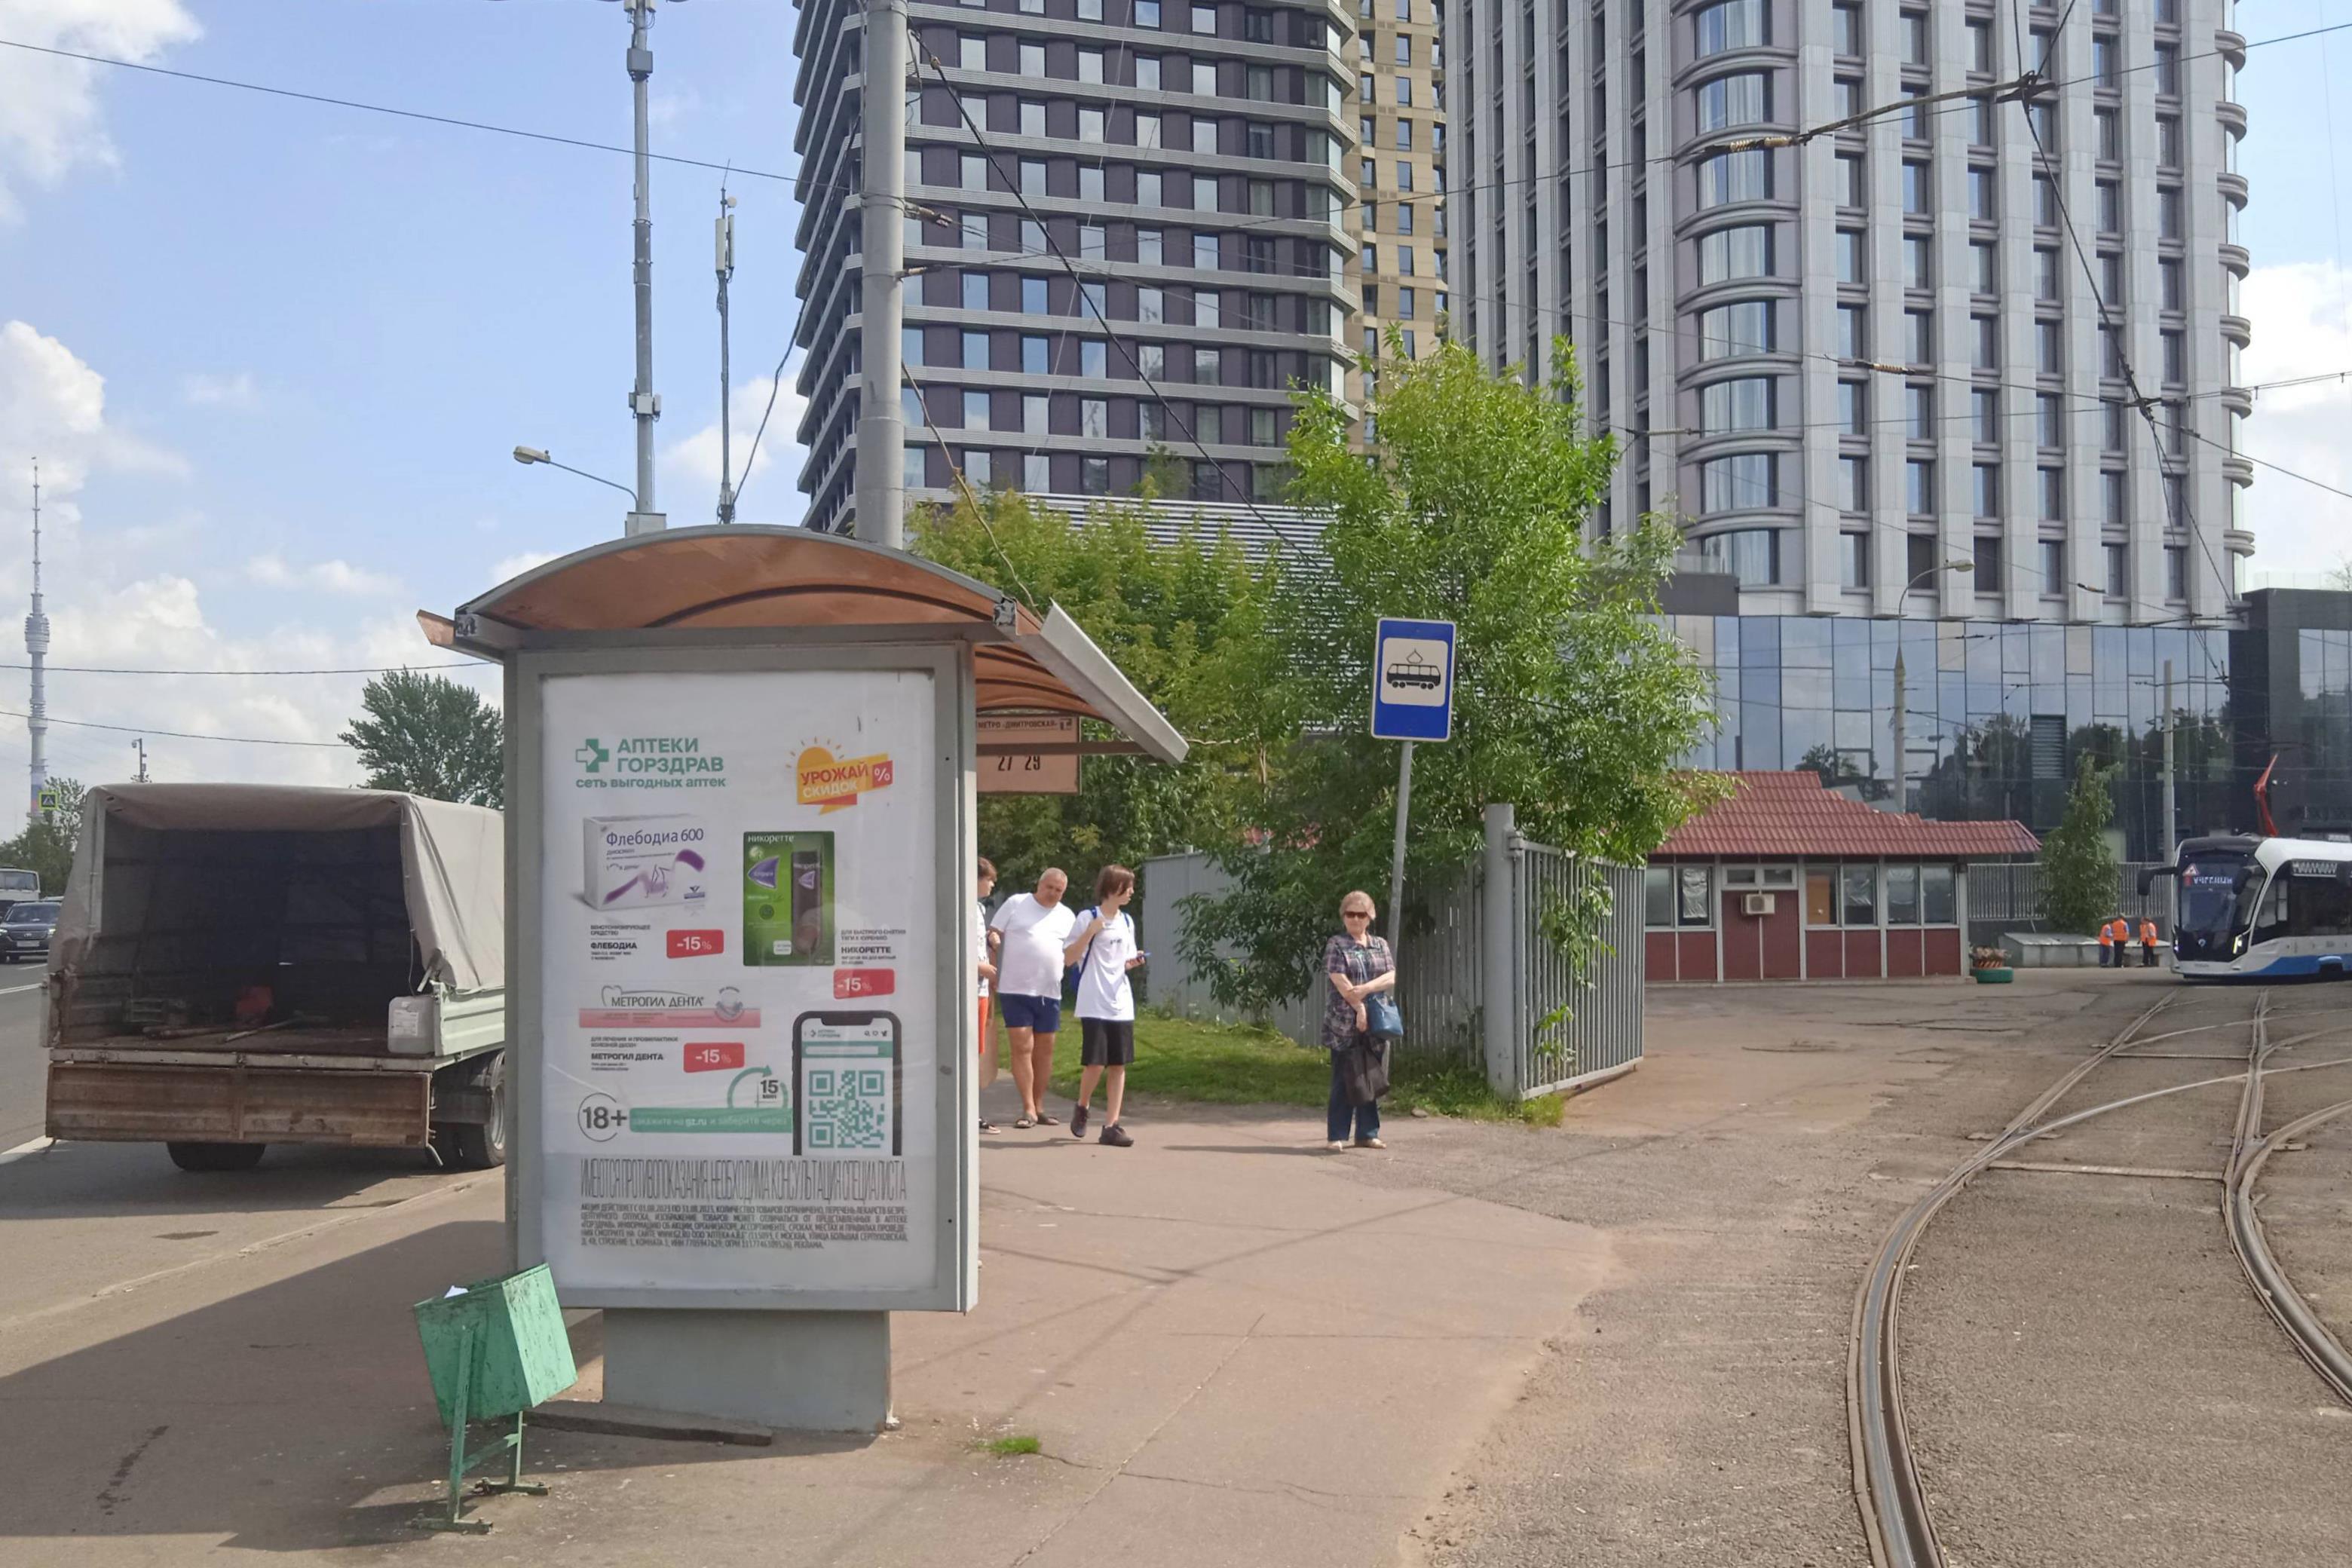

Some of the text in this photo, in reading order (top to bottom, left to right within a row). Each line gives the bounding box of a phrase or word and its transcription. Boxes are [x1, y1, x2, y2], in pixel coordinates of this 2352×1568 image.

[617, 738, 698, 753] АПТЕКИ
[617, 757, 724, 775] ГОРЗДРАВ
[997, 755, 1041, 771] 27 29
[801, 761, 869, 786] УРОЖАЙ
[874, 767, 891, 782] %
[576, 777, 727, 789] сеть выгодных аптек
[803, 781, 857, 798] СКИДОК
[606, 828, 704, 847] Флебодиа 600
[748, 834, 794, 844] никоретте
[611, 997, 666, 1007] МЕТРОГИЛ
[635, 1053, 663, 1061] ДЕНТА
[760, 1080, 779, 1093] 15
[582, 1106, 627, 1129] 18+
[685, 1118, 707, 1128] gz.ru
